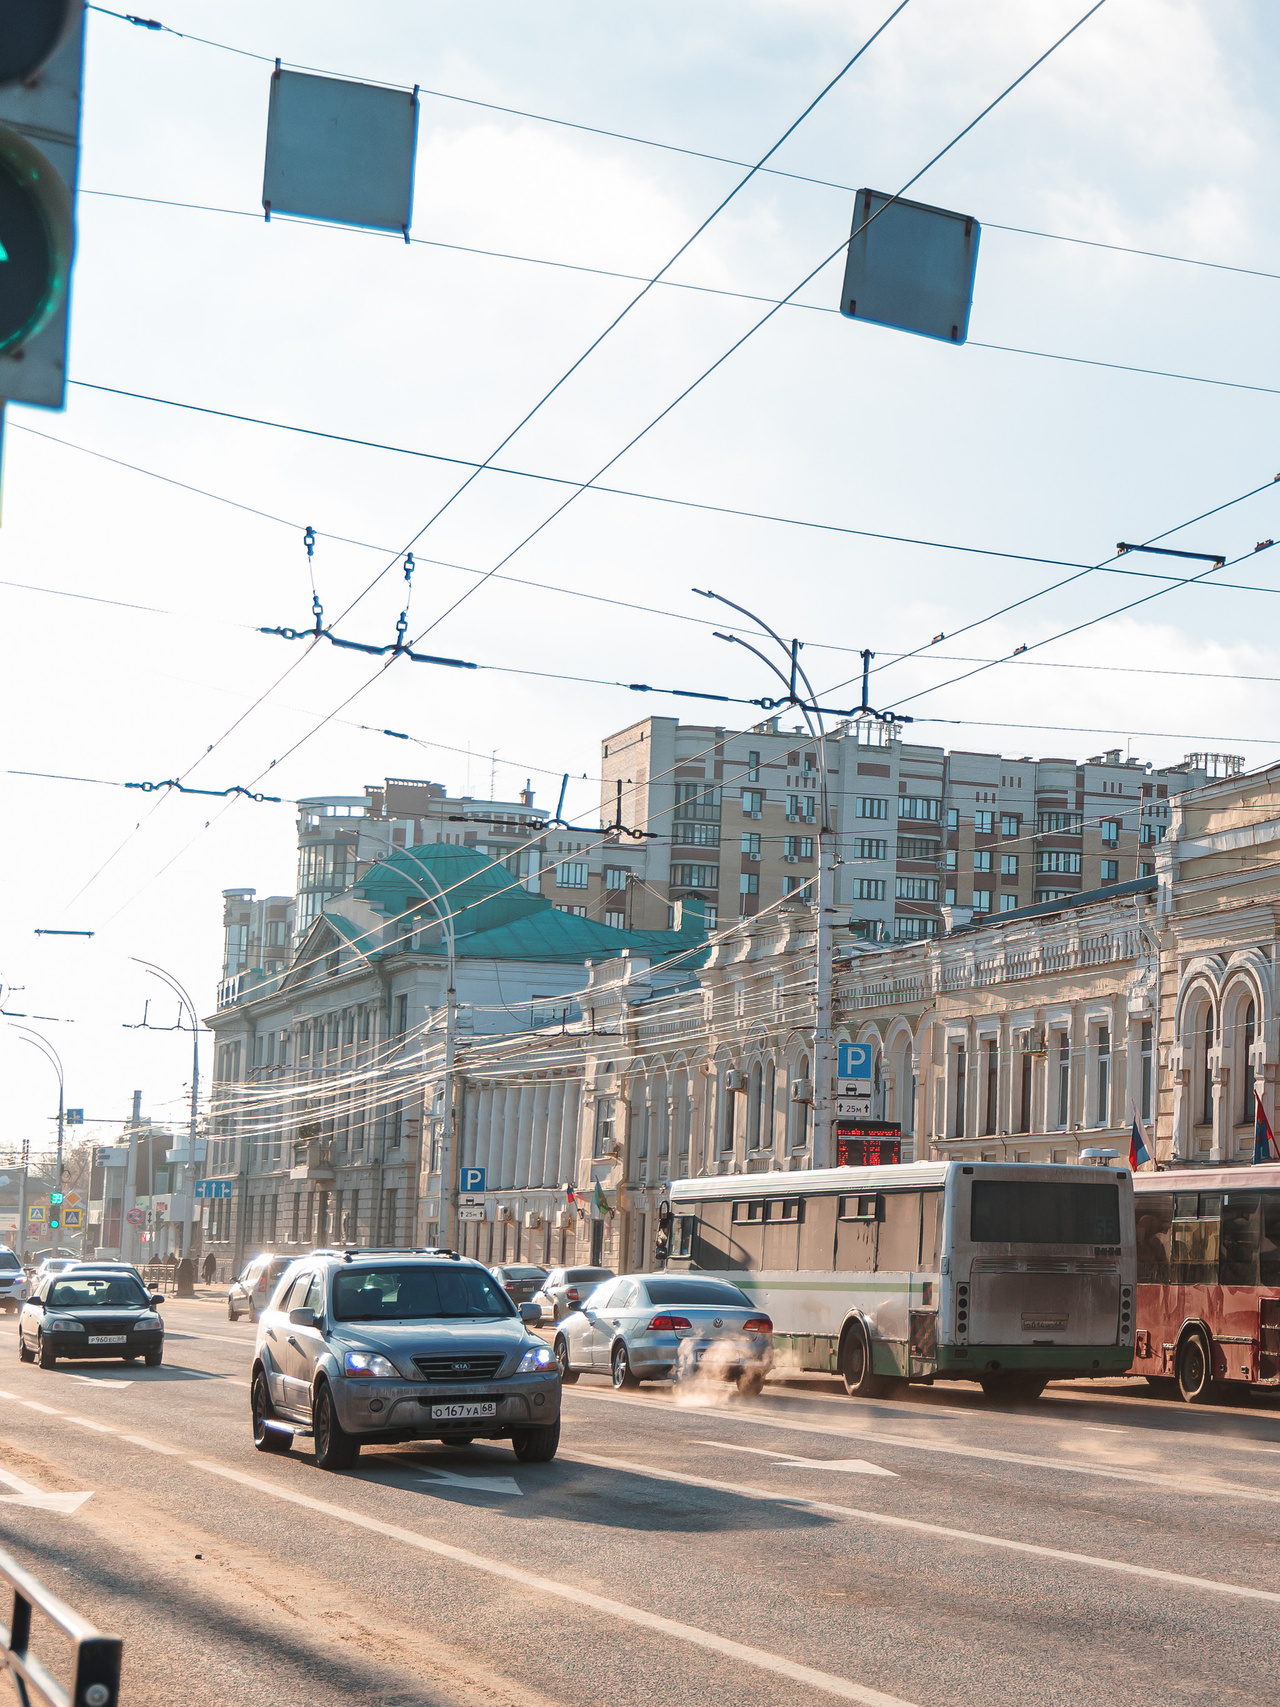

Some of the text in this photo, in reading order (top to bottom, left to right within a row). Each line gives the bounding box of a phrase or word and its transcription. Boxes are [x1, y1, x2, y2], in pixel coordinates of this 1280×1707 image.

[846, 1047, 866, 1075] P
[846, 1105, 862, 1113] 25м
[467, 1170, 482, 1190] P
[482, 1403, 493, 1412] 68
